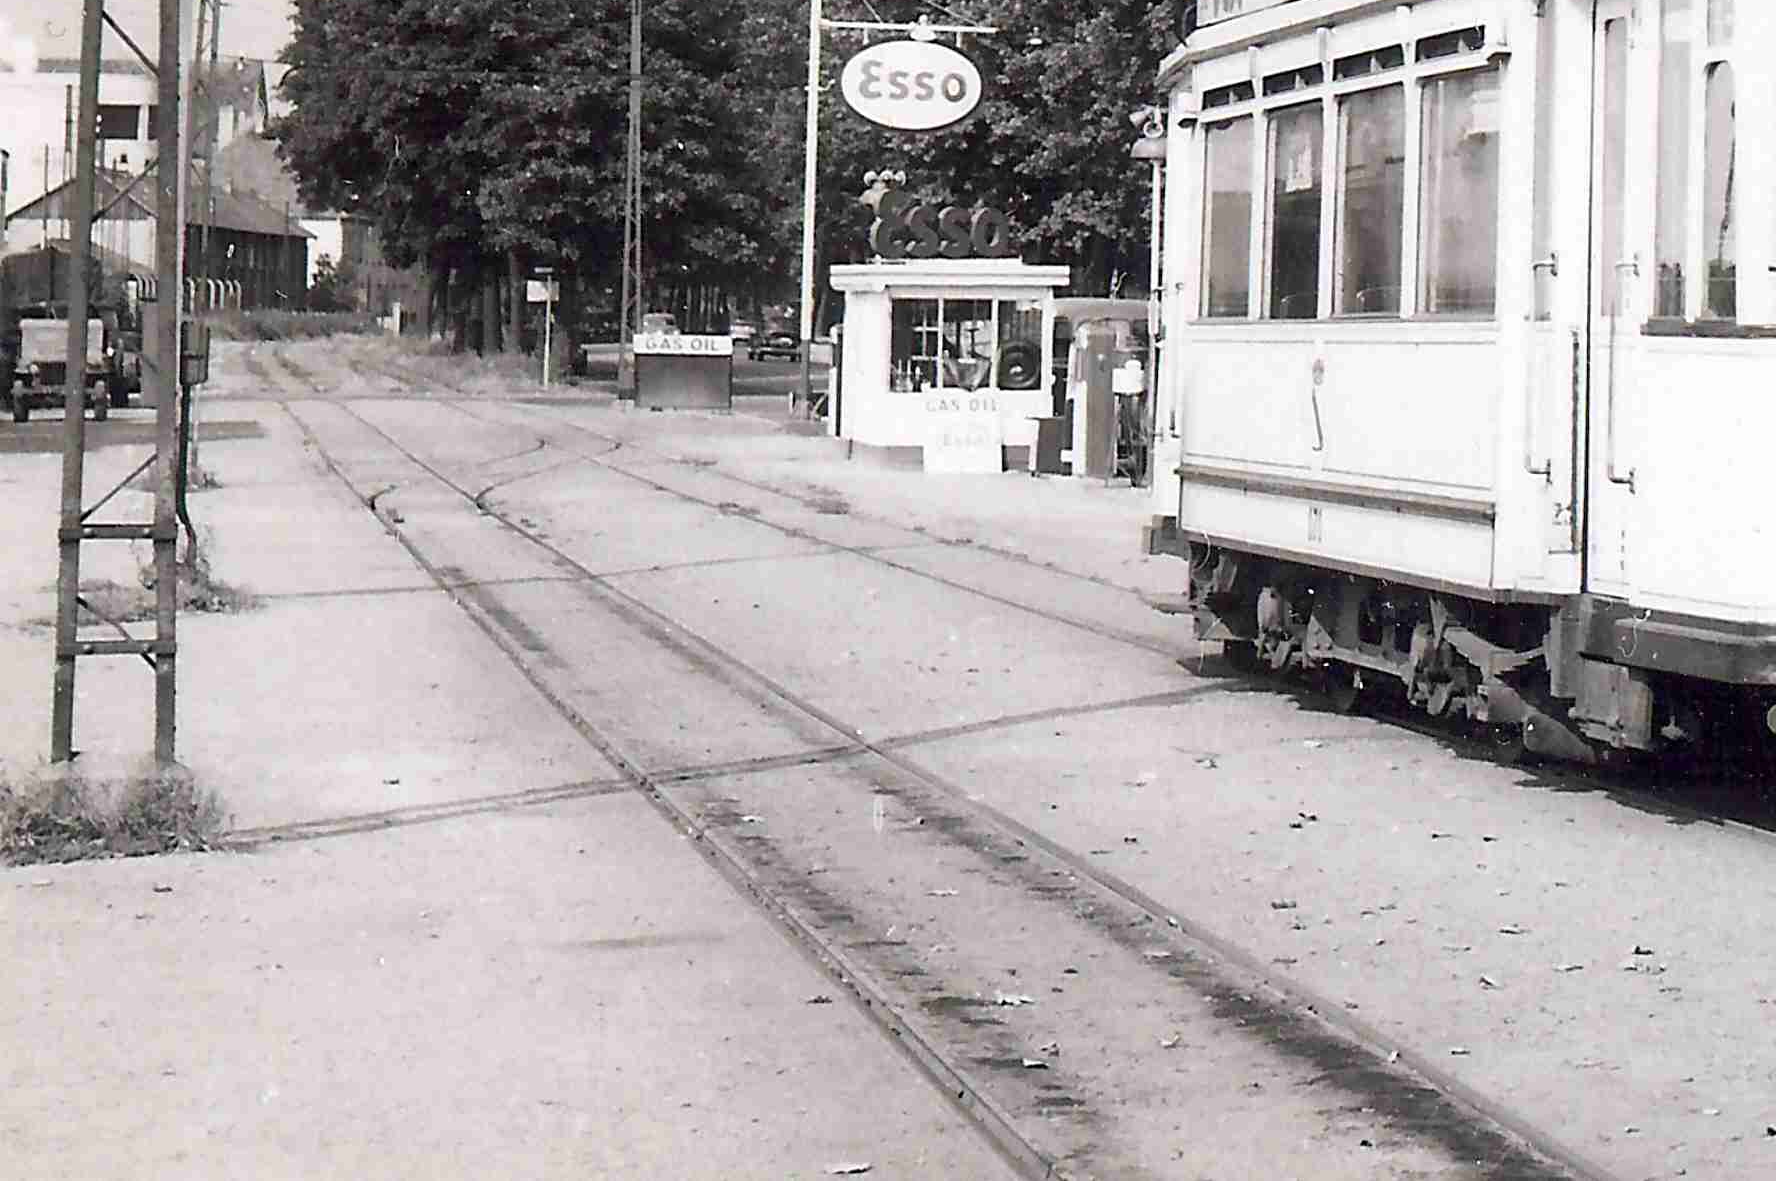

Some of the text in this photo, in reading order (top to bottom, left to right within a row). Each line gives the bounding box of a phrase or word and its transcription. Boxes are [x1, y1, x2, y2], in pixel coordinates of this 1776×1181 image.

[645, 337, 720, 352] GAS OIL
[968, 398, 998, 413] OIL
